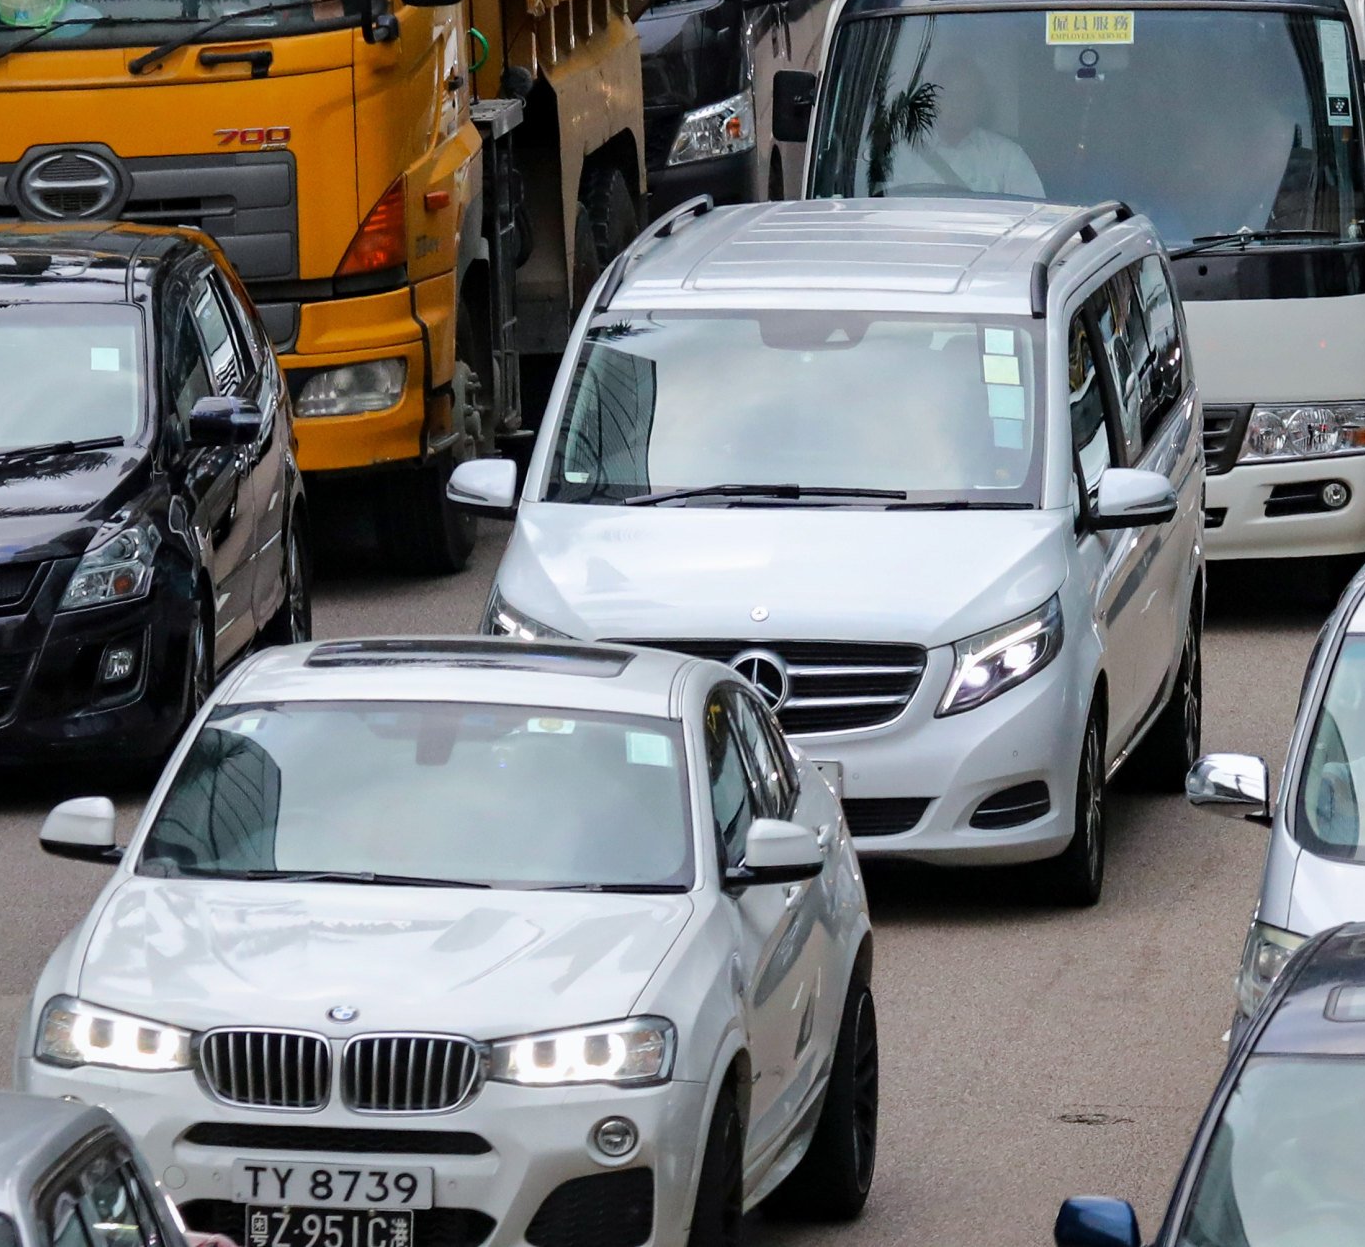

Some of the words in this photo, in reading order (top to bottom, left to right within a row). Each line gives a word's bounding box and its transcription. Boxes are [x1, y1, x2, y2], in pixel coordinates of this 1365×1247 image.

[213, 126, 291, 146] 700
[244, 1166, 295, 1199] TY
[310, 1168, 419, 1203] 8739
